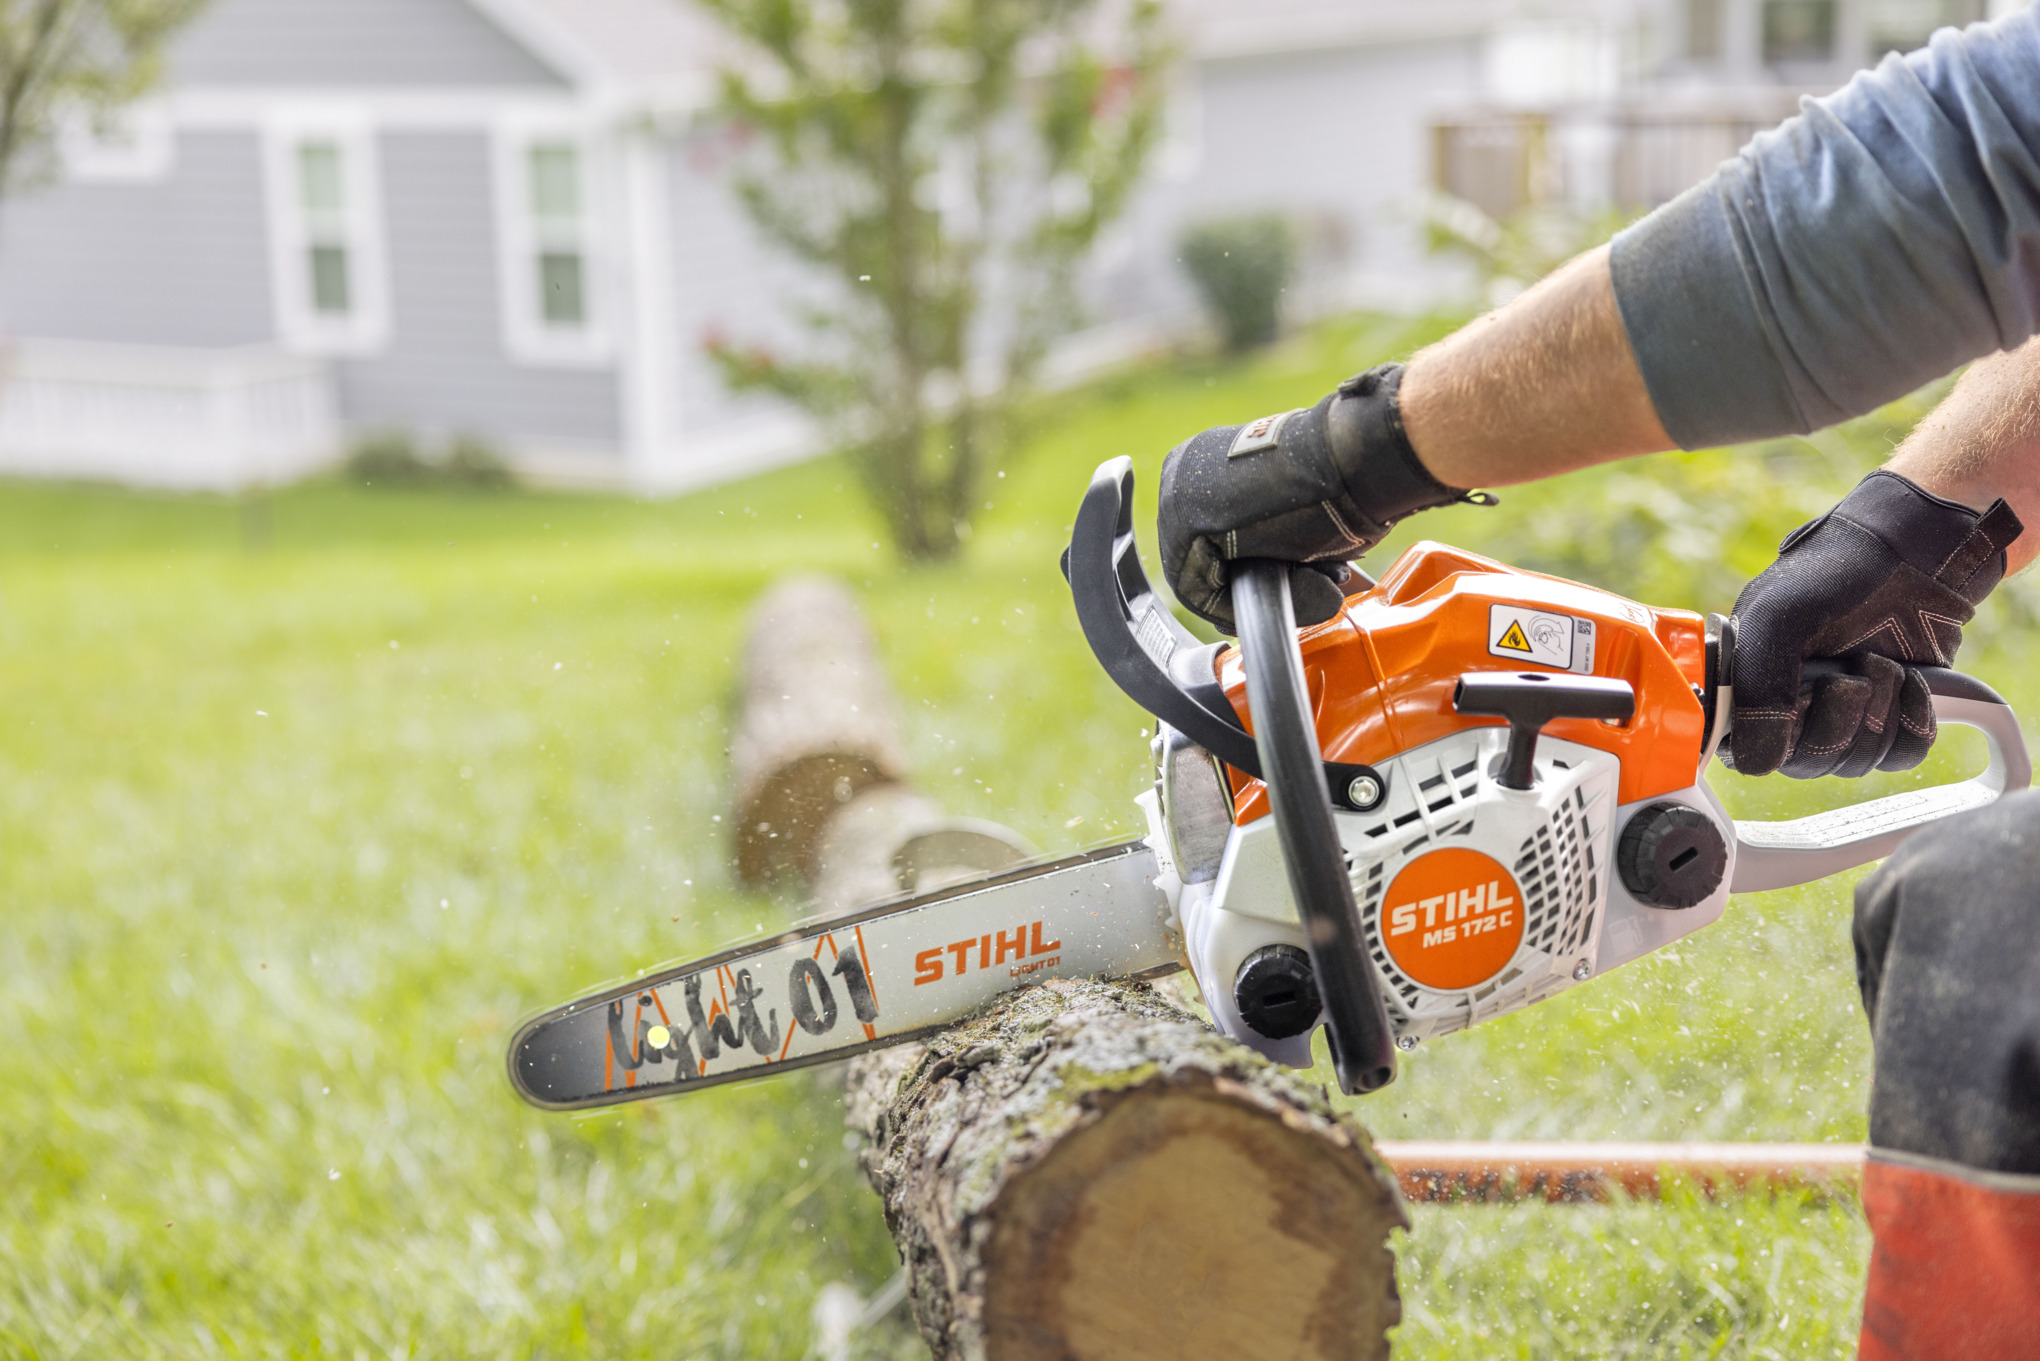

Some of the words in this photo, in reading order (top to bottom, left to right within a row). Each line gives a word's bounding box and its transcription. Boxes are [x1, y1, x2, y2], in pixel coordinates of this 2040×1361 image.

[1391, 881, 1513, 936] STIHL
[1423, 926, 1456, 948] MS
[1461, 915, 1496, 938] 172
[1500, 911, 1513, 927] C
[914, 921, 1061, 986] STIHL
[789, 945, 878, 1036] 01
